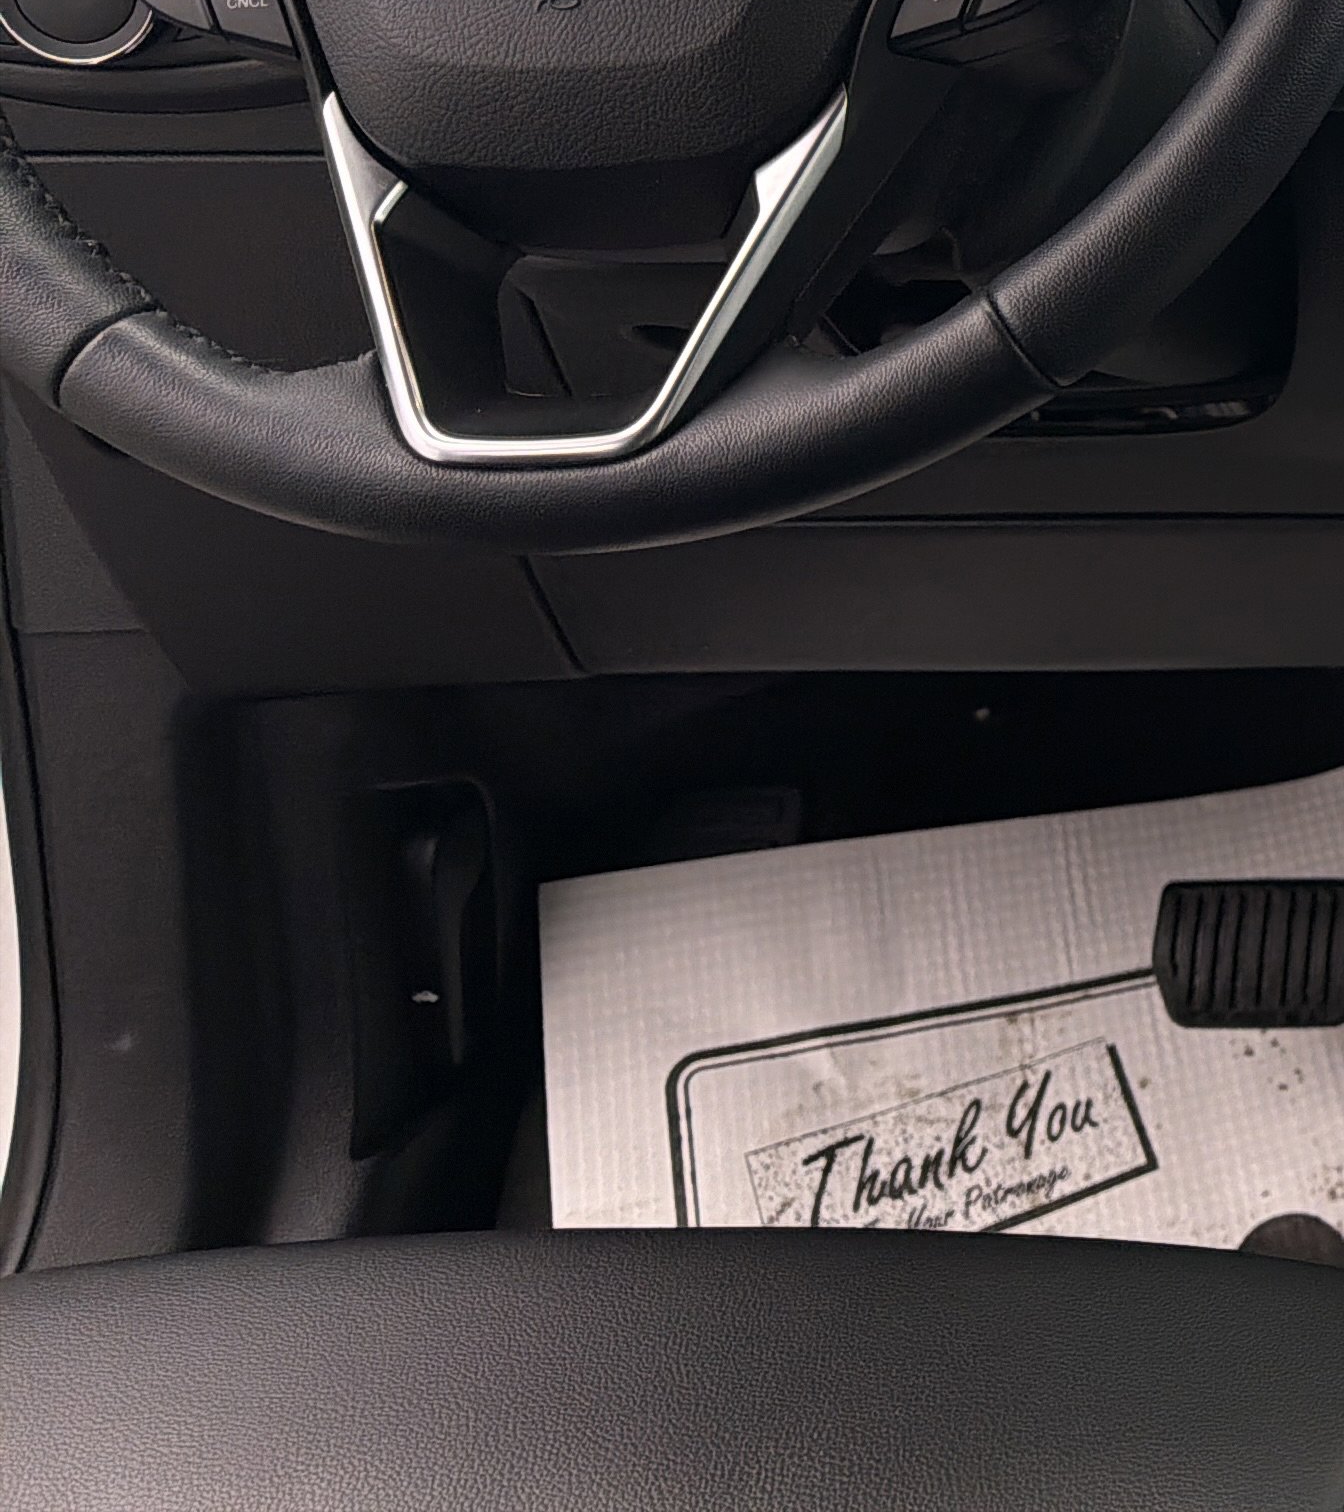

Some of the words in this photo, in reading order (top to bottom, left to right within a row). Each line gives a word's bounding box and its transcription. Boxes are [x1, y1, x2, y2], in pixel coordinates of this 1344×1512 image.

[802, 1097, 988, 1228] Thank
[1006, 1068, 1099, 1160] You
[964, 1165, 1070, 1220] Patronage
